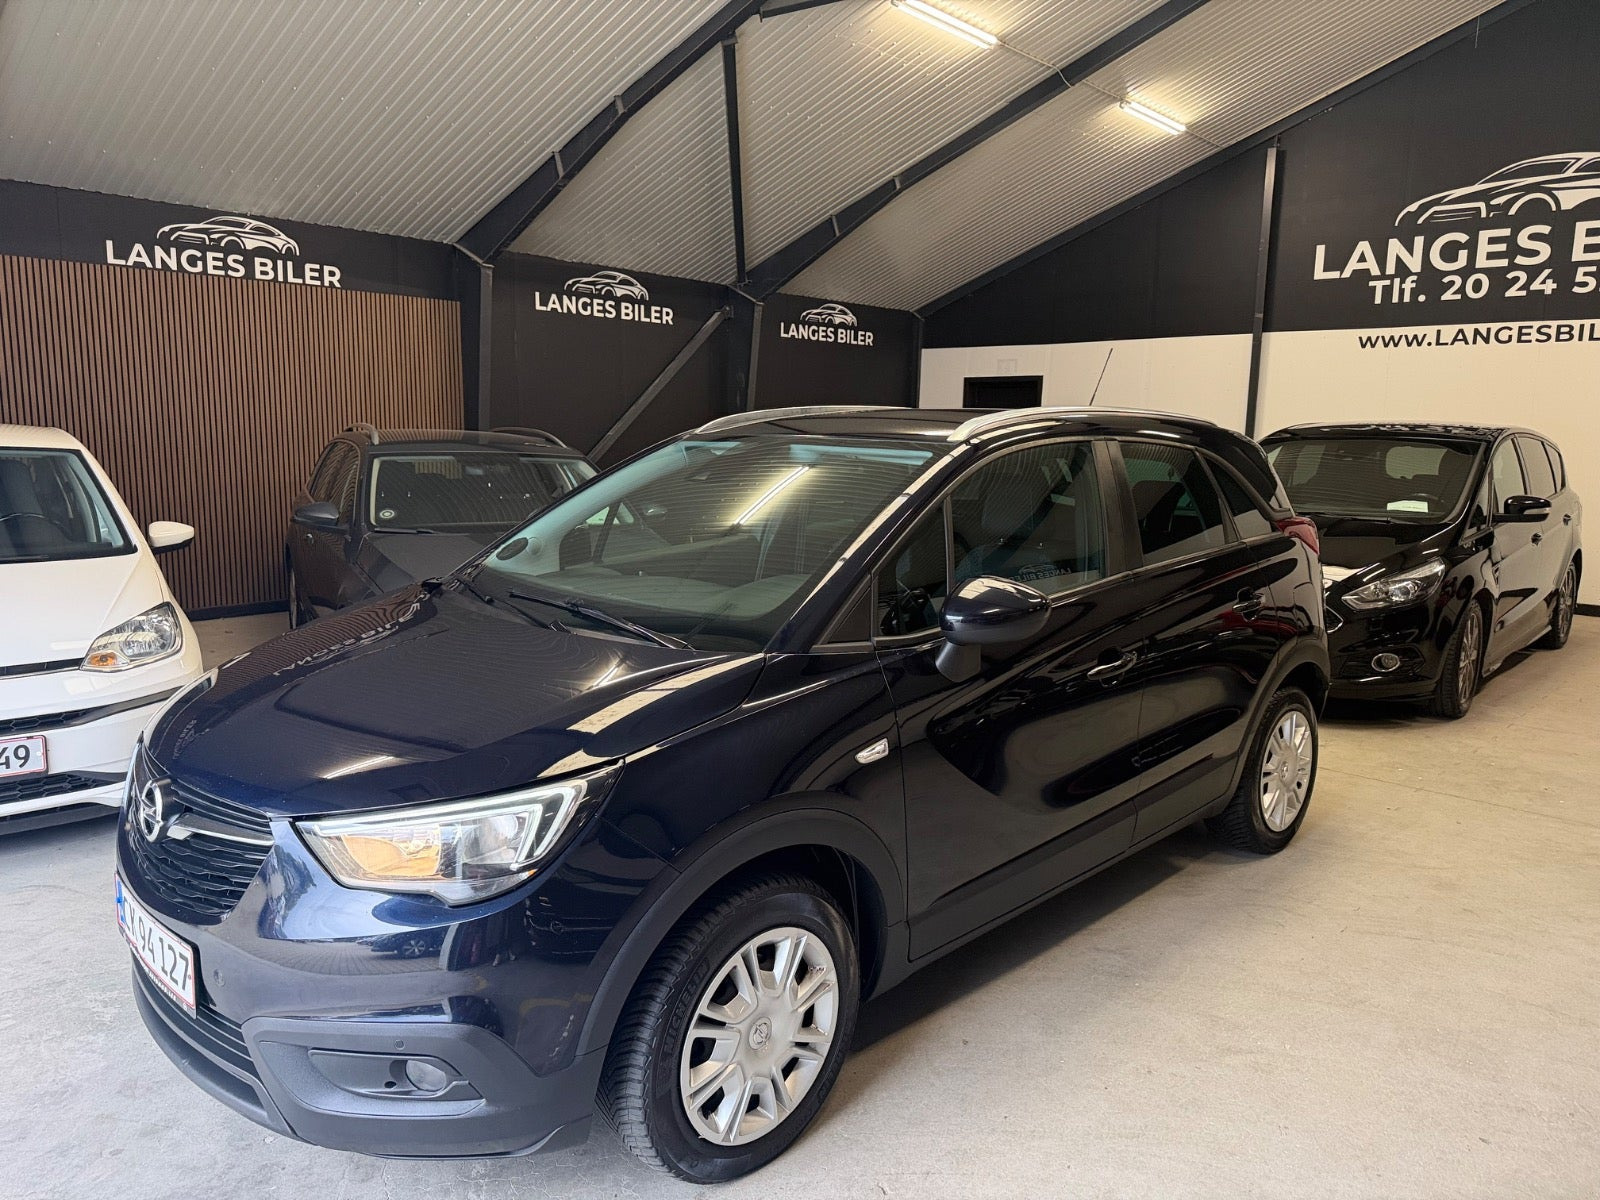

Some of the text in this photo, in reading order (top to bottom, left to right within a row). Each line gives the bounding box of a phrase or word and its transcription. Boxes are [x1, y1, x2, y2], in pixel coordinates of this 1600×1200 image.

[105, 239, 342, 288] LANGES BILER
[1313, 224, 1552, 281] LANGES
[1368, 265, 1600, 305] Tlf. 20 24 5
[534, 291, 674, 325] LANGES BILER
[780, 322, 874, 346] LANGES BILER
[139, 918, 156, 964] 94
[159, 936, 189, 991] 127
